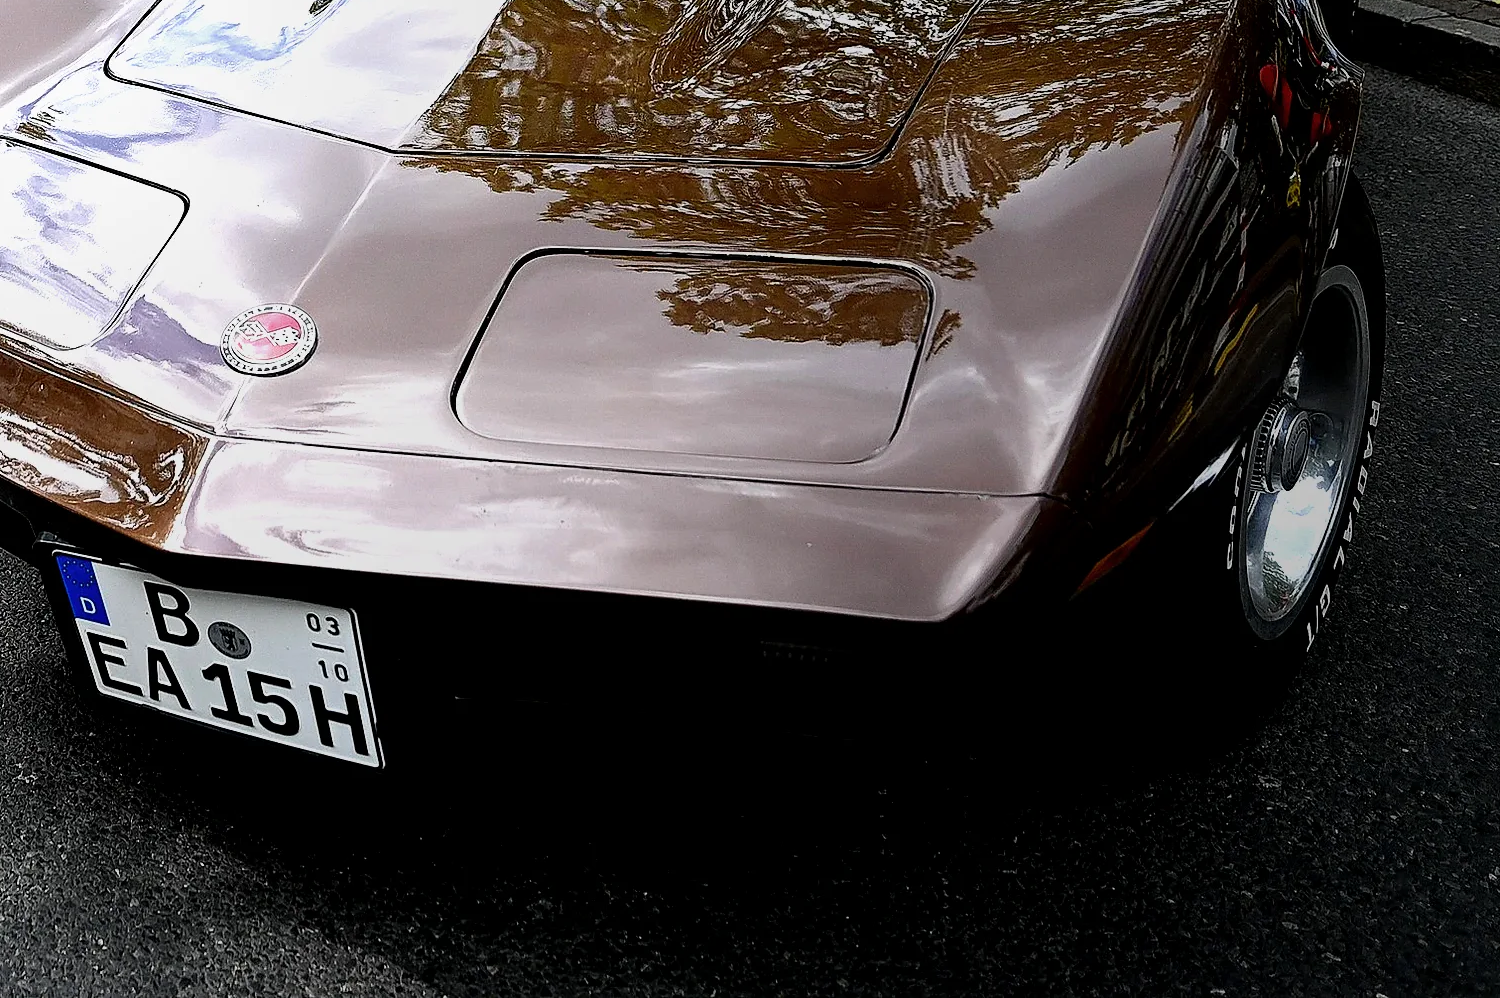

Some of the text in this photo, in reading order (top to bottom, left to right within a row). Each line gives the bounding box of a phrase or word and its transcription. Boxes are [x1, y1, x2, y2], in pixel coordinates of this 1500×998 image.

[1333, 400, 1381, 570] RADIAL
[80, 580, 200, 647] D B
[306, 612, 341, 636] 03
[317, 659, 350, 683] 10
